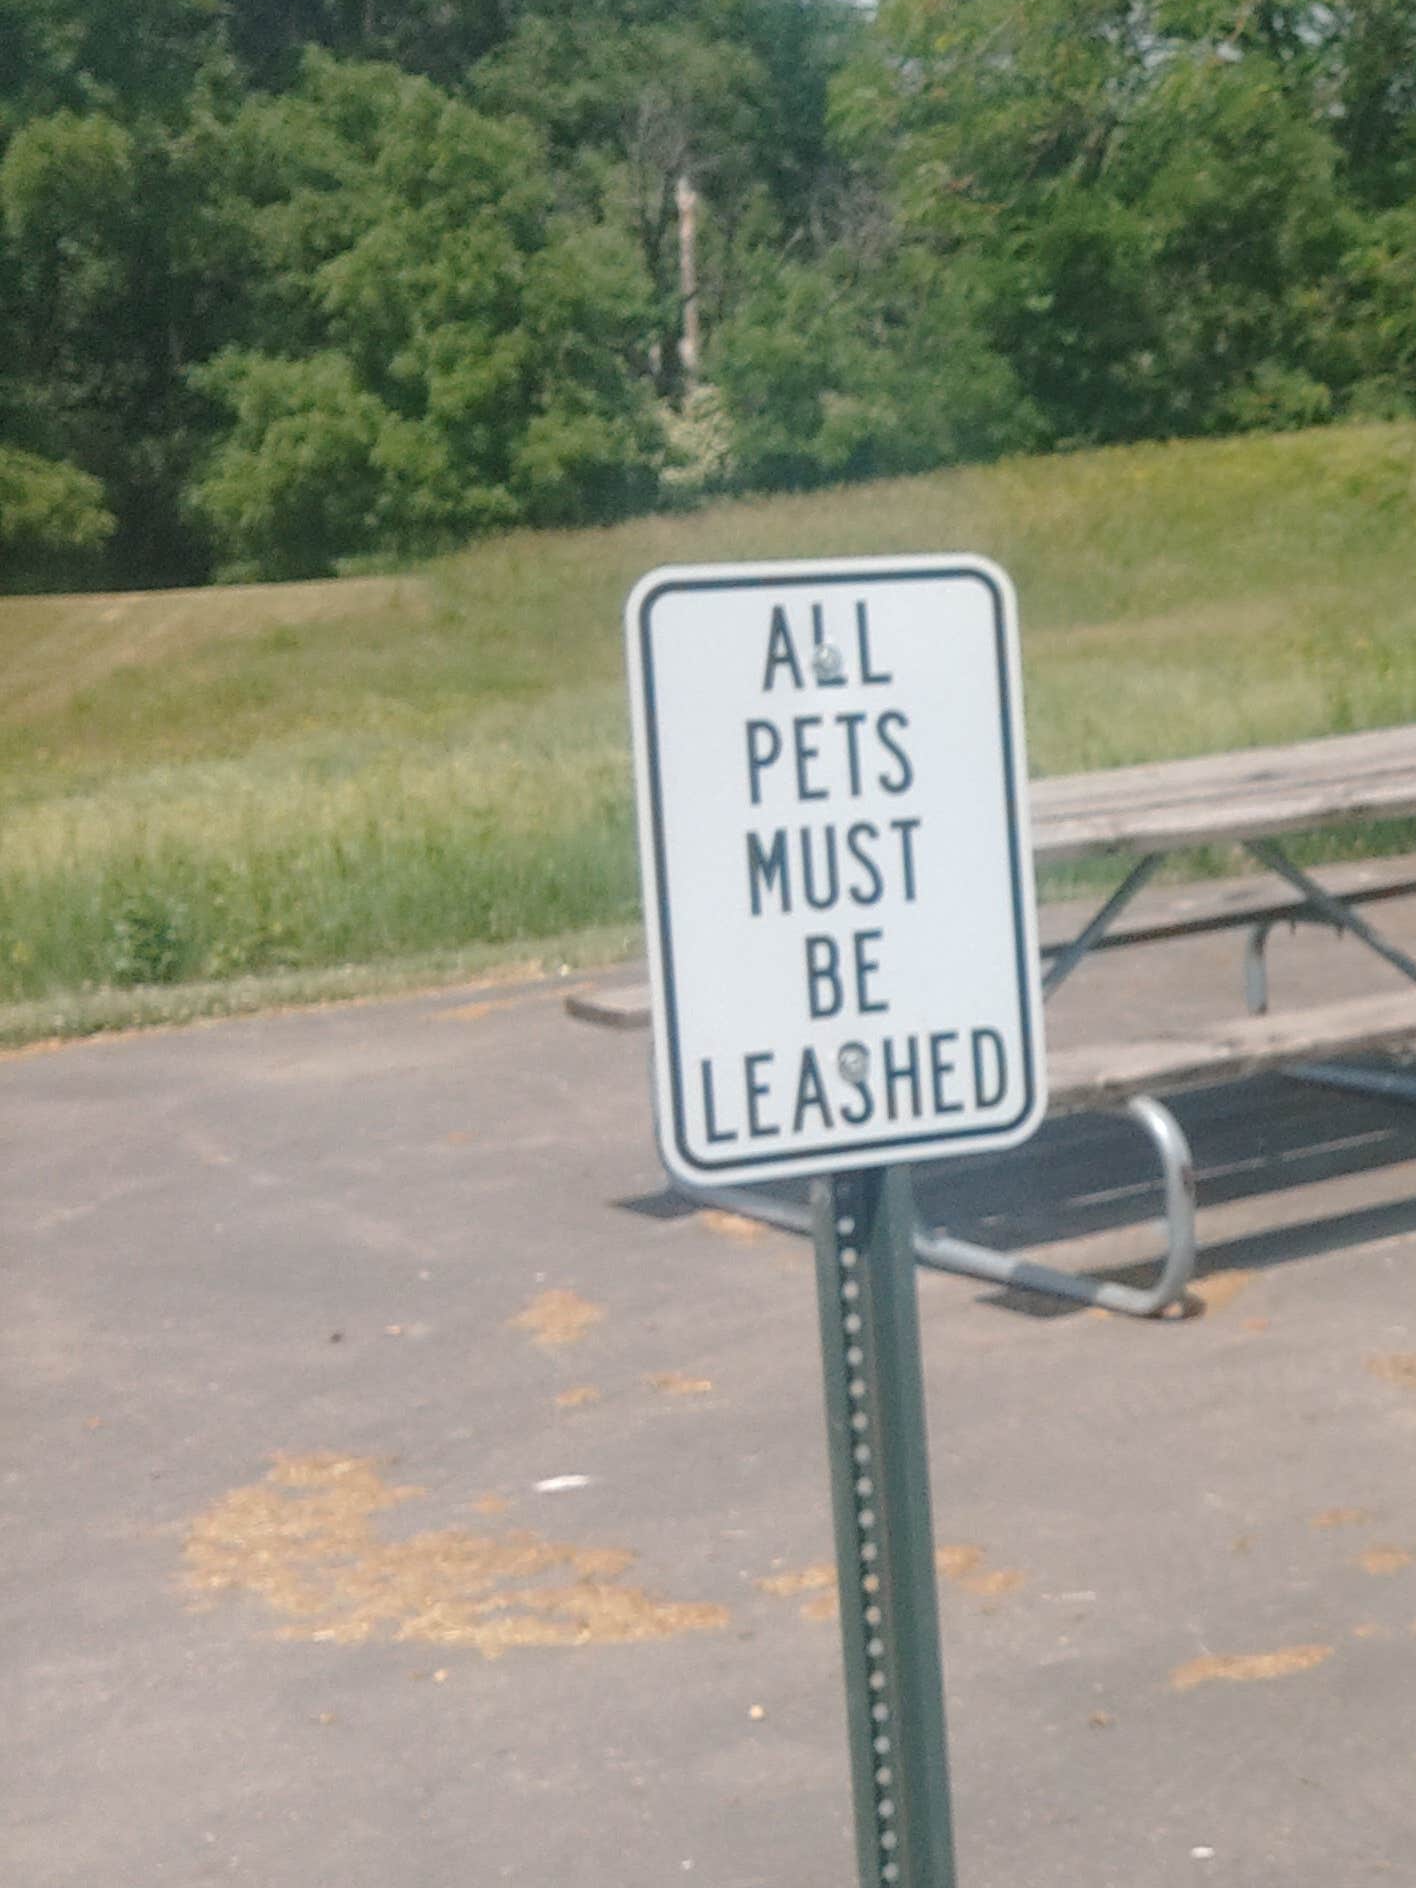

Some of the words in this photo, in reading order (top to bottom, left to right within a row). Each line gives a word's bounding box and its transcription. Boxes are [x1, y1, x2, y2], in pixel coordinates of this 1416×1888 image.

[762, 600, 893, 692] ALL
[745, 710, 914, 806] PETS
[745, 818, 921, 917] MUST
[804, 929, 890, 1019] BE
[700, 1028, 1008, 1144] LEASHED
